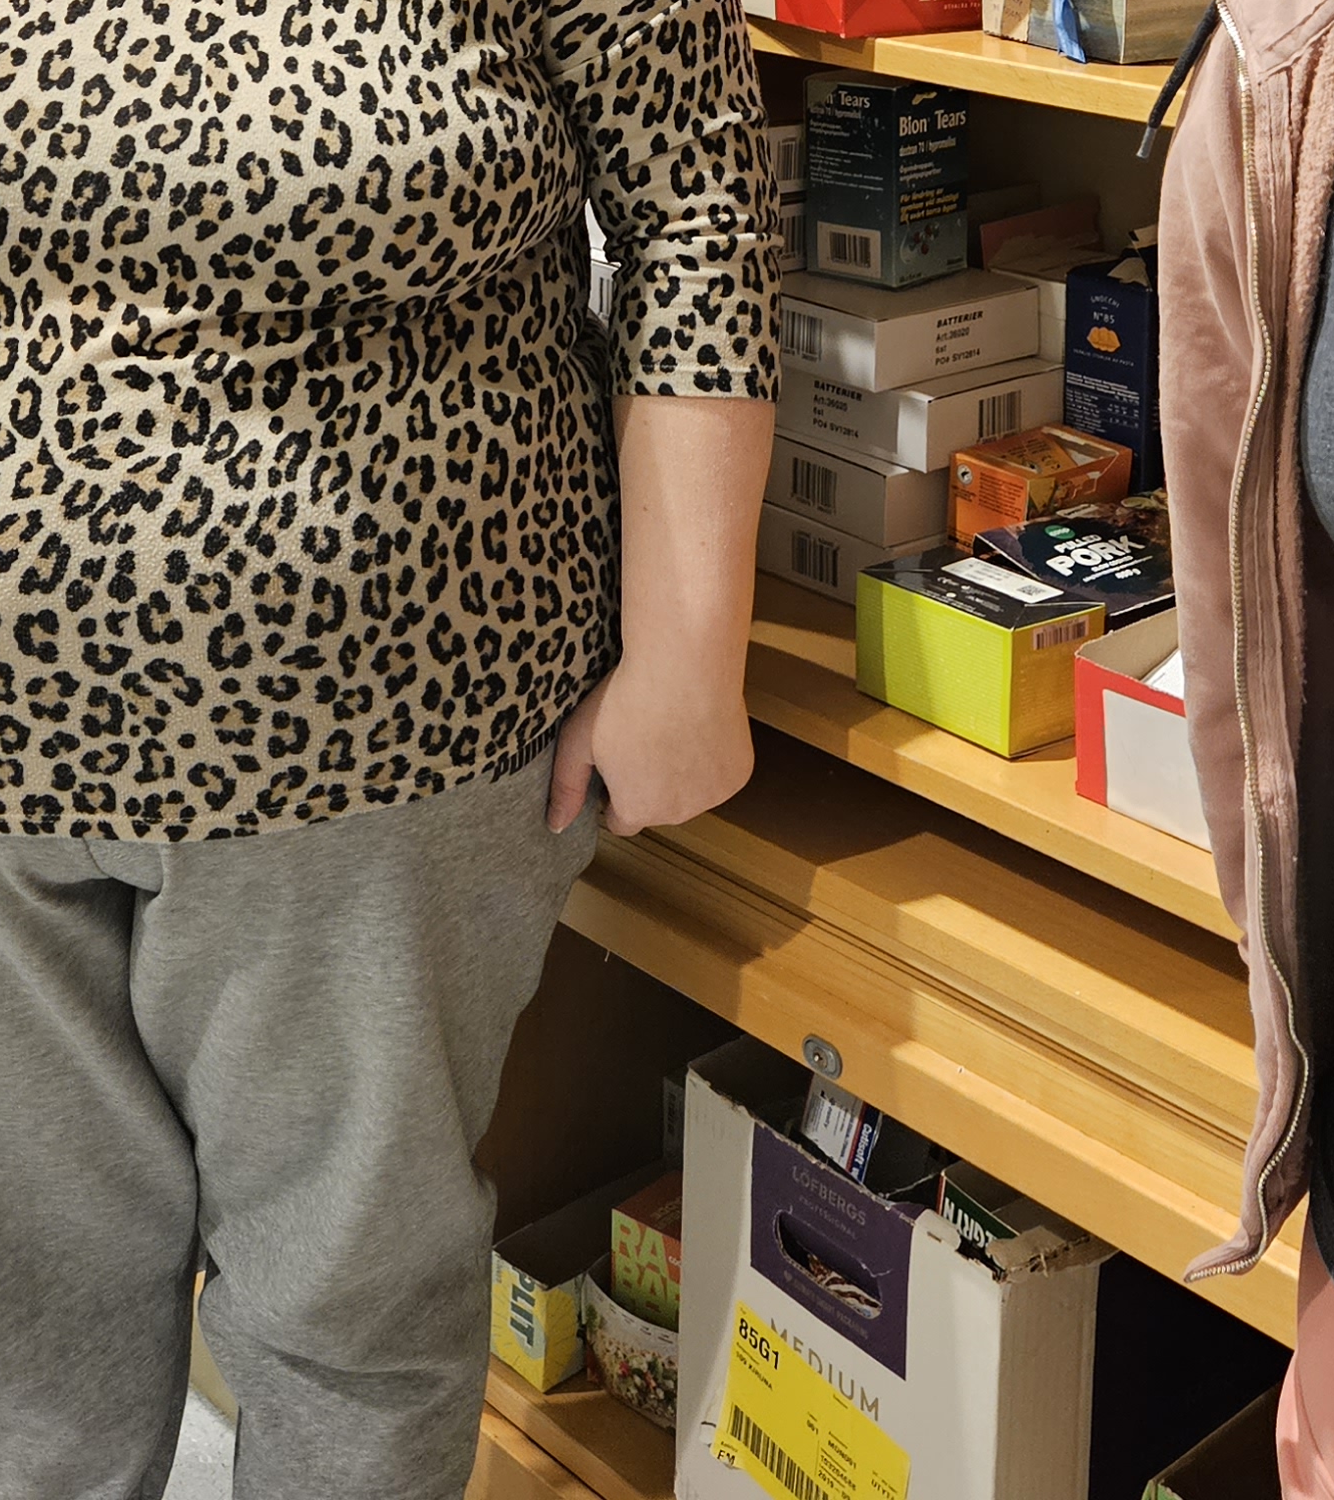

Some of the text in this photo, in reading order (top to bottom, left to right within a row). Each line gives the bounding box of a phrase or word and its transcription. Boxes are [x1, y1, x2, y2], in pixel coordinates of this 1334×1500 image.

[838, 90, 871, 109] Tears
[899, 109, 967, 137] Bion Tears
[936, 310, 984, 328] BATTERIER
[813, 380, 863, 402] BATTERIER
[1045, 534, 1147, 577] PORK
[1053, 533, 1103, 554] PULLED
[854, 1123, 873, 1165] Cutisoft
[792, 1165, 867, 1227] LÖFBERGS
[738, 1317, 780, 1371] 85G1
